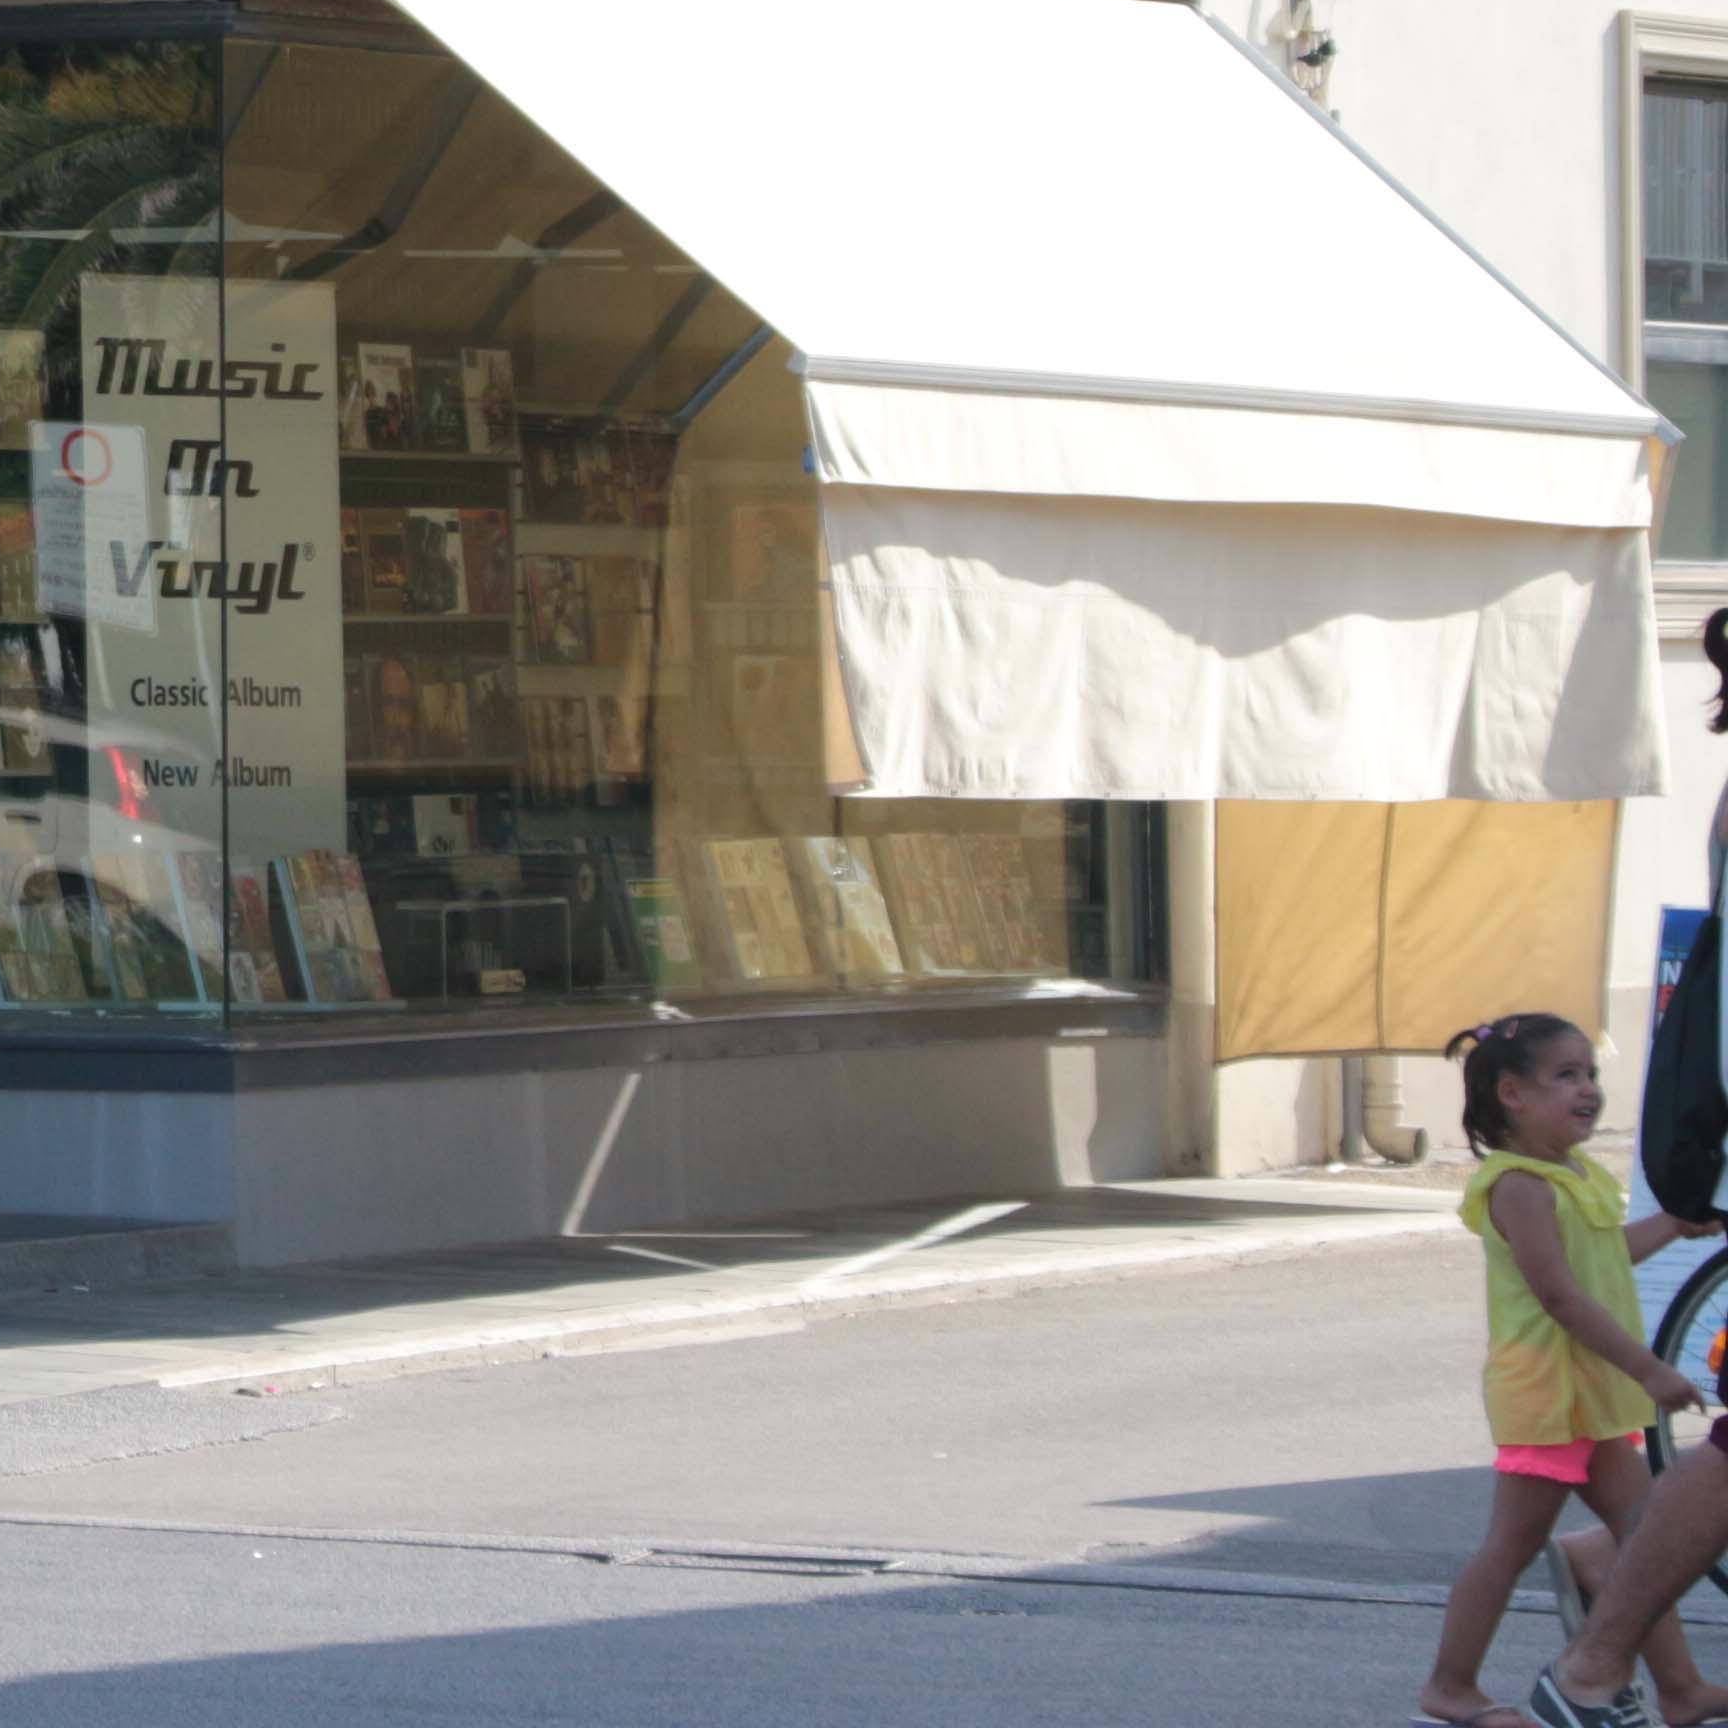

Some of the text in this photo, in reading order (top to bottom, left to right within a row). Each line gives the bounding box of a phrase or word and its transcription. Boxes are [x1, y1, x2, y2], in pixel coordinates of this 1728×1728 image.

[95, 336, 324, 401] Music
[163, 438, 261, 498] On
[130, 676, 302, 709] Classic Album
[143, 756, 292, 788] New Album
